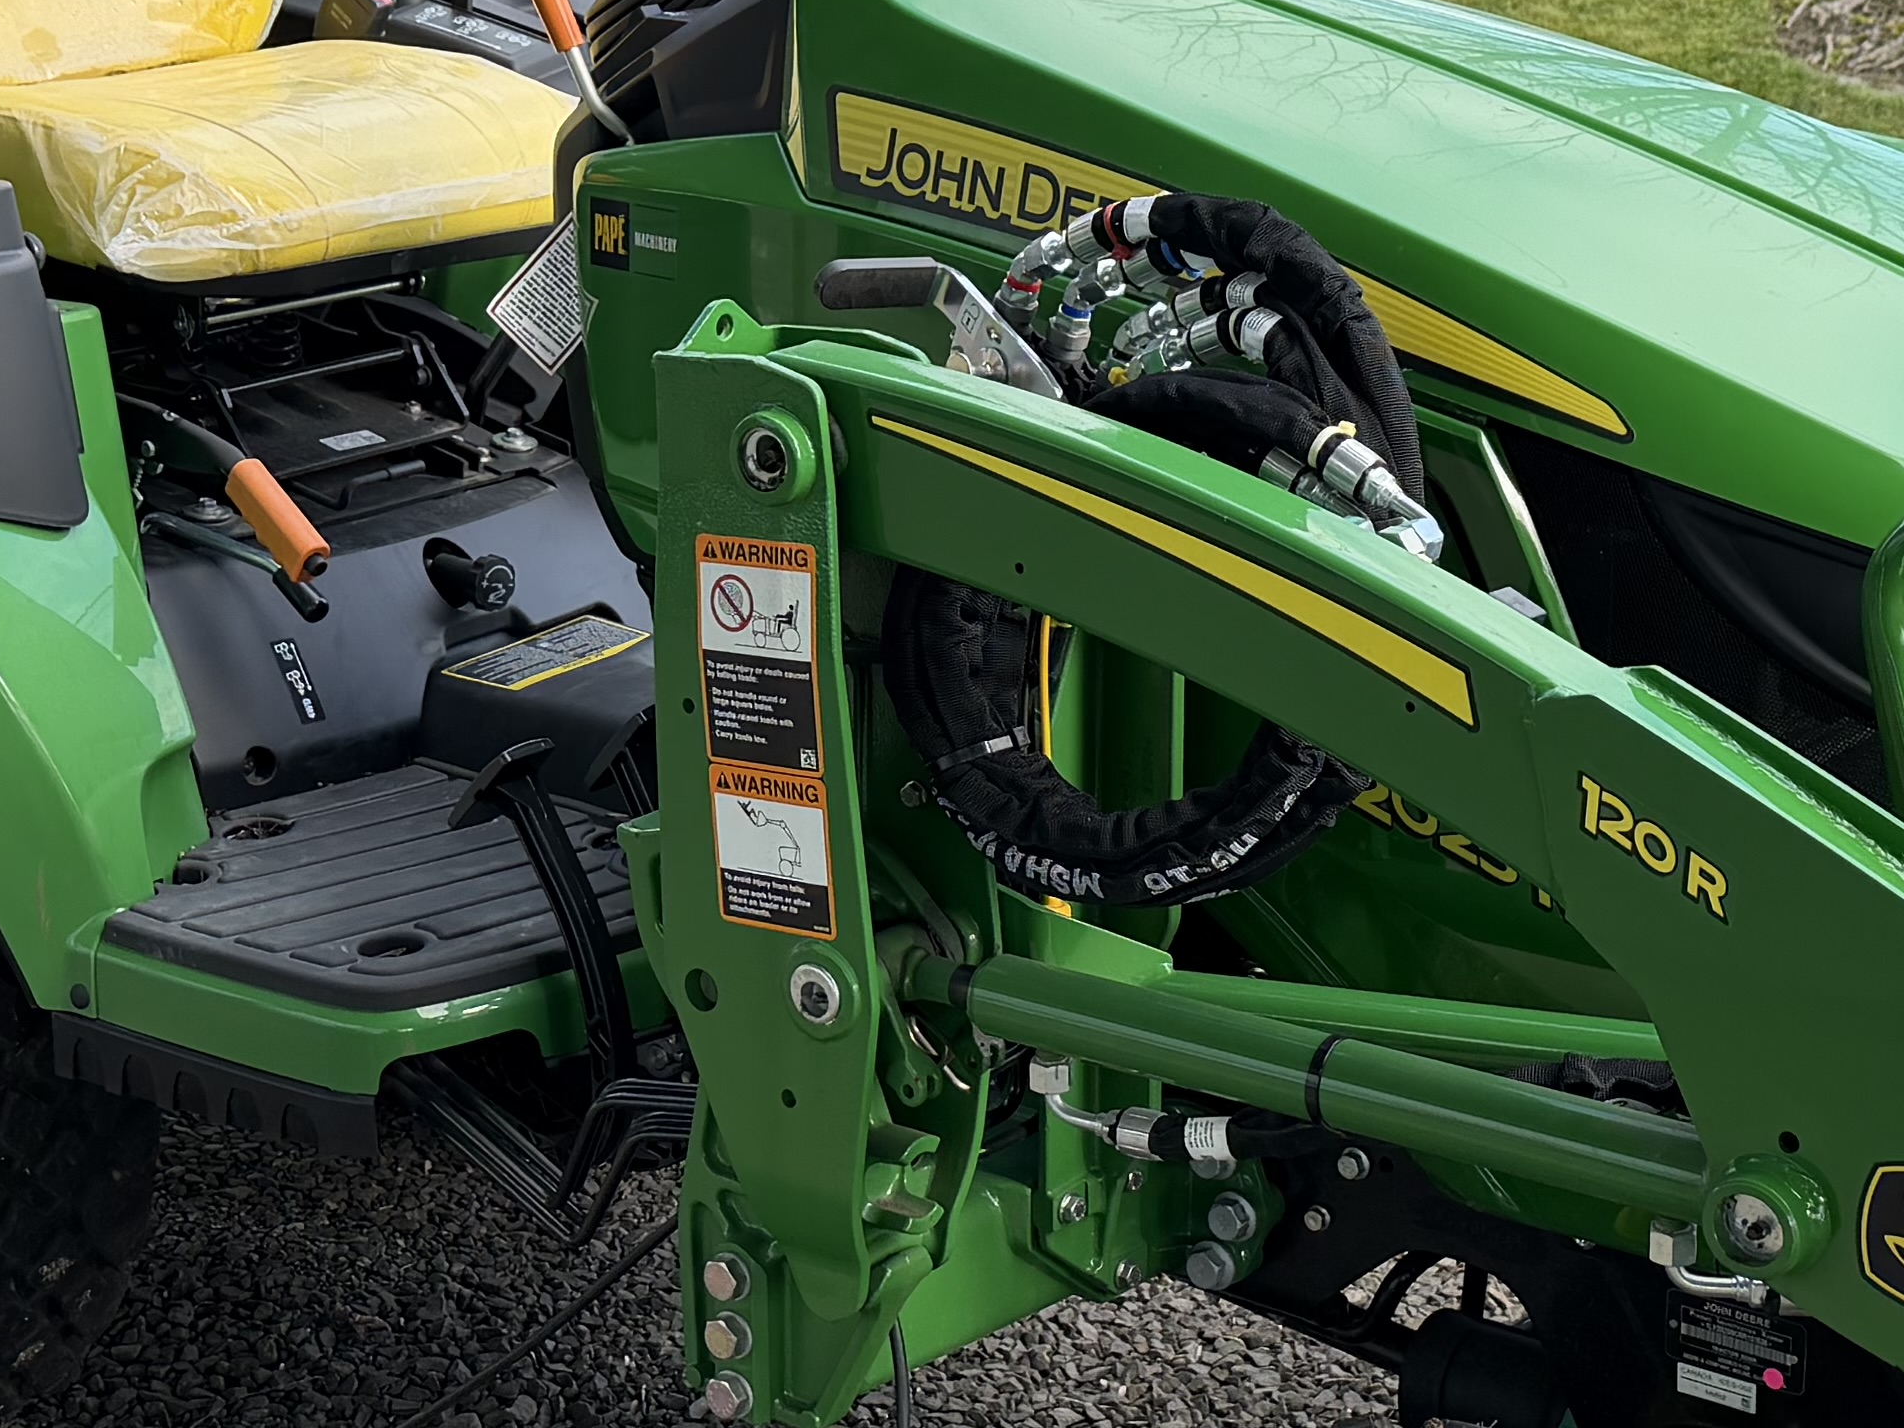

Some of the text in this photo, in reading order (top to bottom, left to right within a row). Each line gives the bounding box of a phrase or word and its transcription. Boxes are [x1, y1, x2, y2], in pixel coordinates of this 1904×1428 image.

[865, 127, 1006, 213] JOHN
[634, 231, 677, 253] MACHINERY
[719, 541, 808, 568] WARNING
[732, 772, 820, 803] WARNING
[1704, 1303, 1770, 1328] JOHN DEERE
